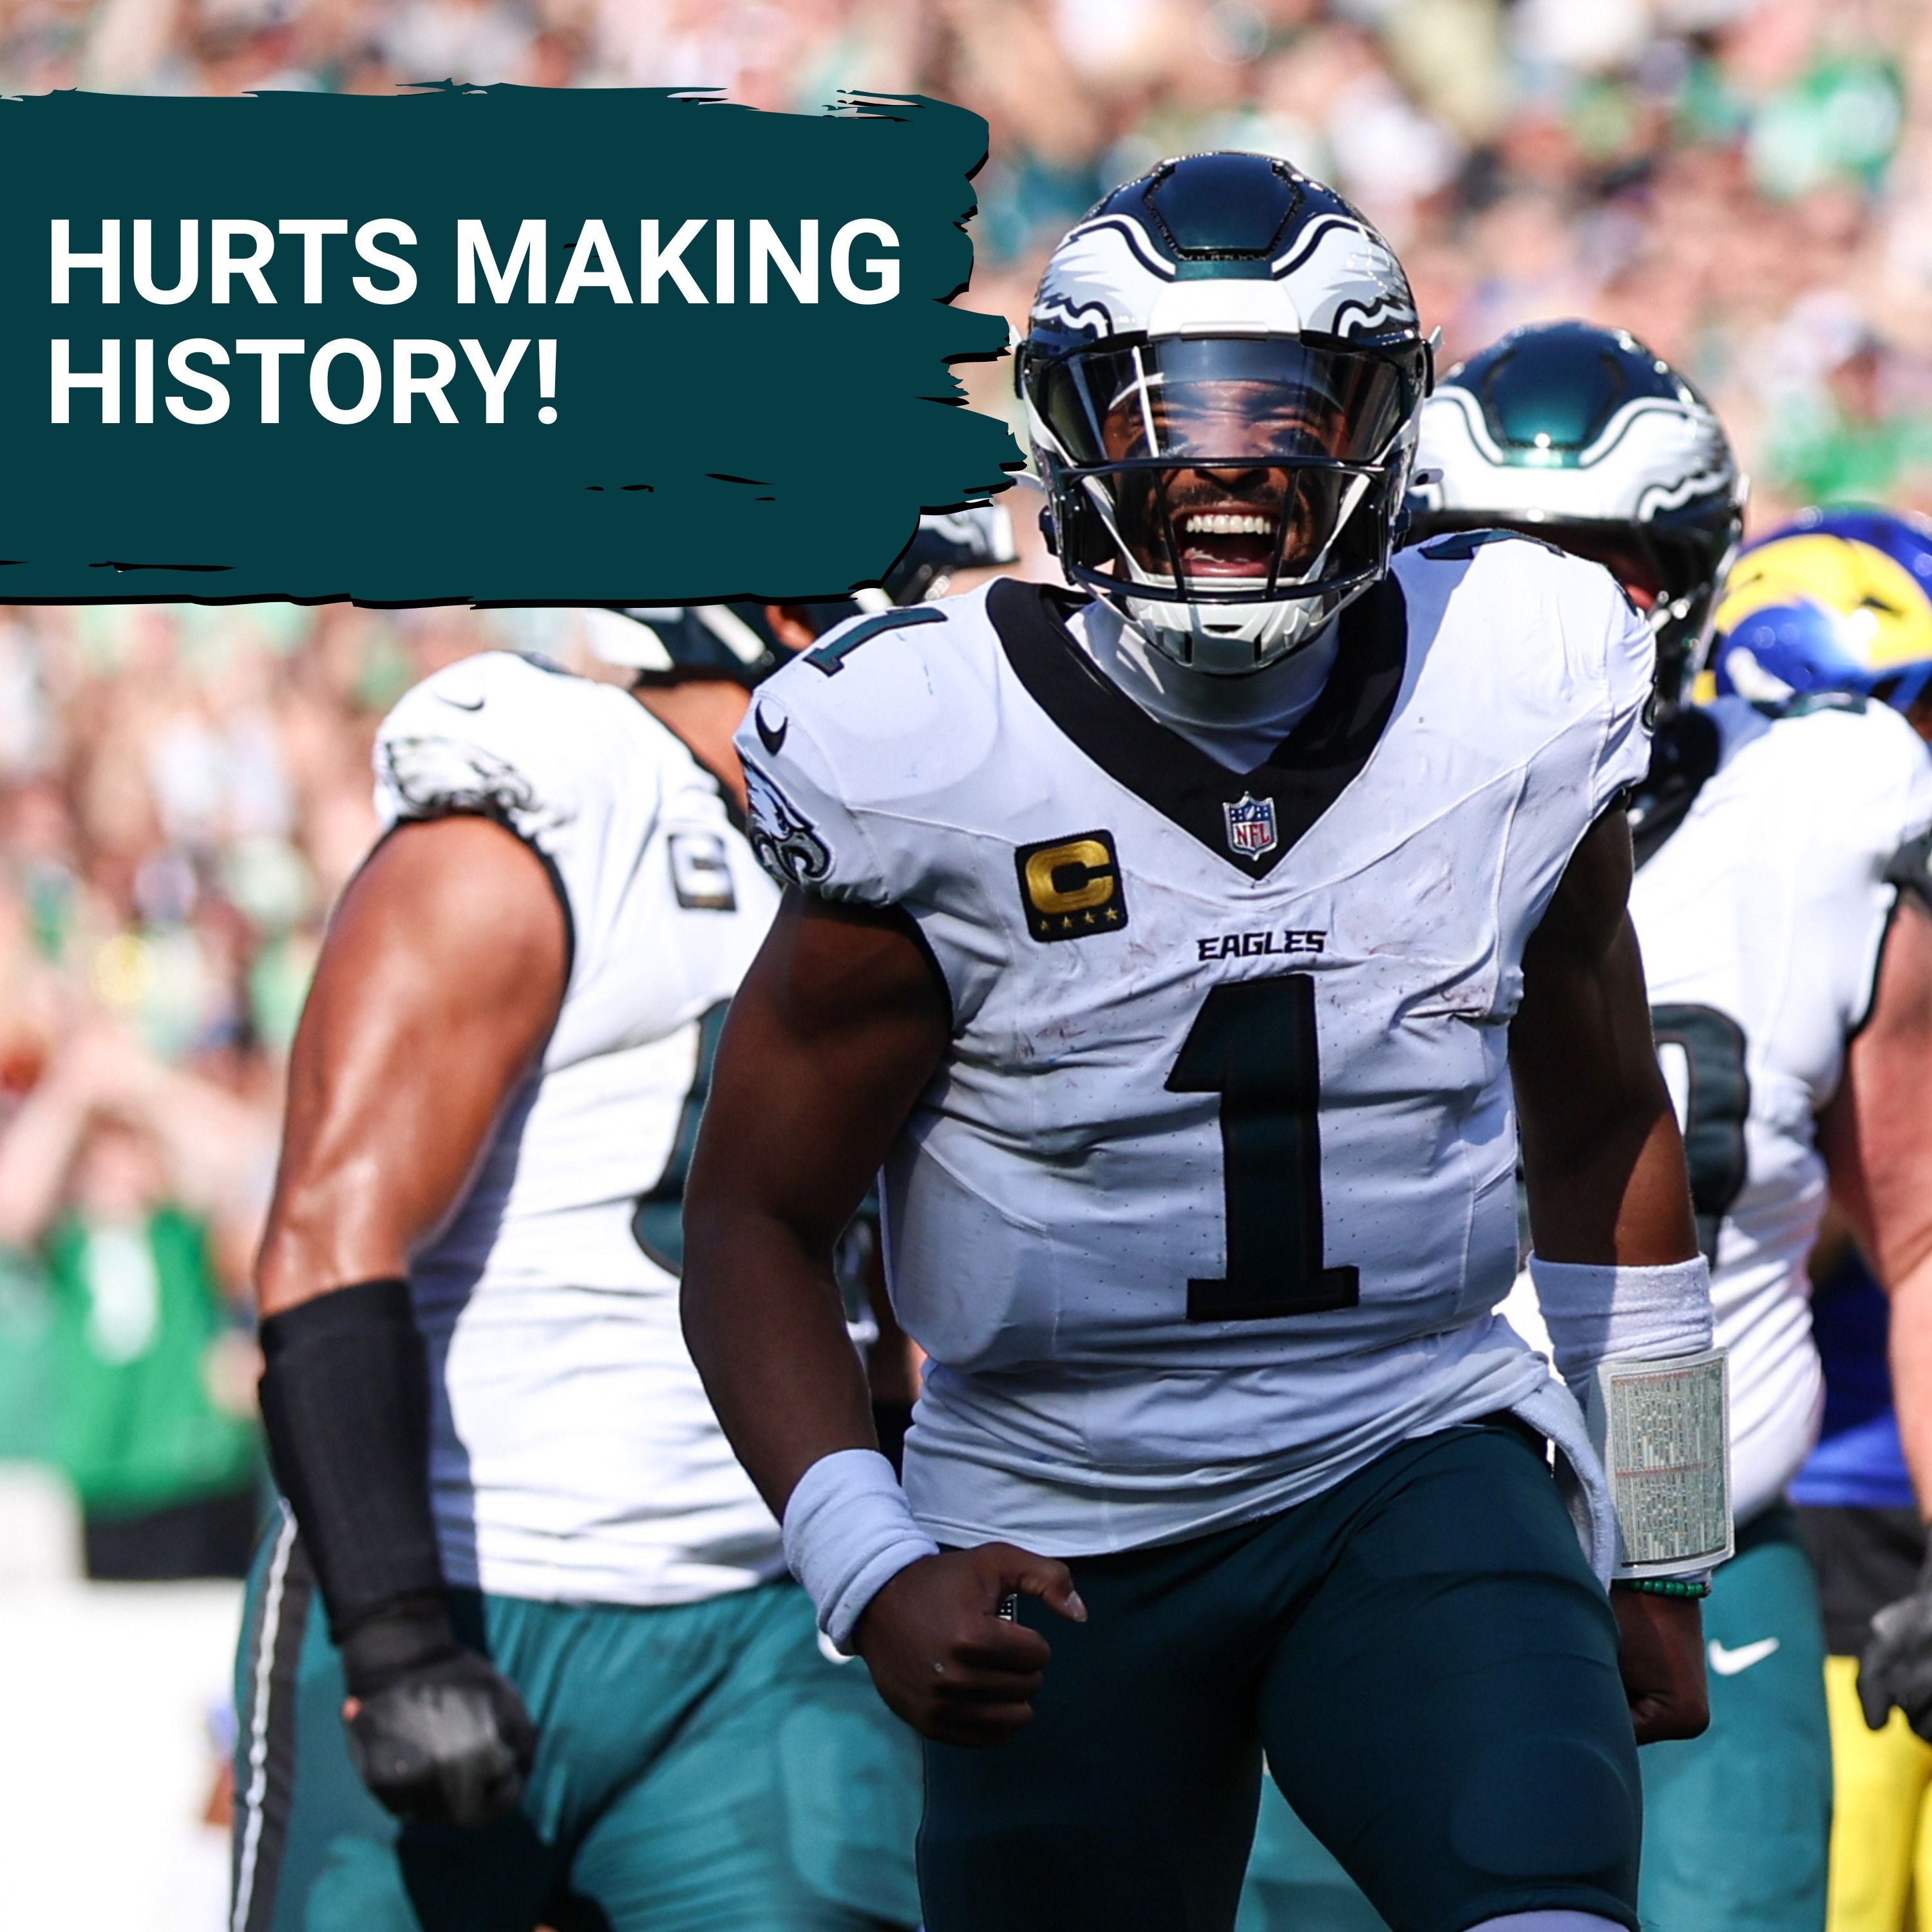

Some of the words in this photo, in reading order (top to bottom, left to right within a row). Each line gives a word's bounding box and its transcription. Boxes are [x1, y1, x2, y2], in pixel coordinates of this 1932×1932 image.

[1235, 824, 1270, 846] NFL
[1025, 839, 1115, 916] C
[1197, 929, 1328, 962] EAGLES
[1164, 973, 1359, 1321] 1
